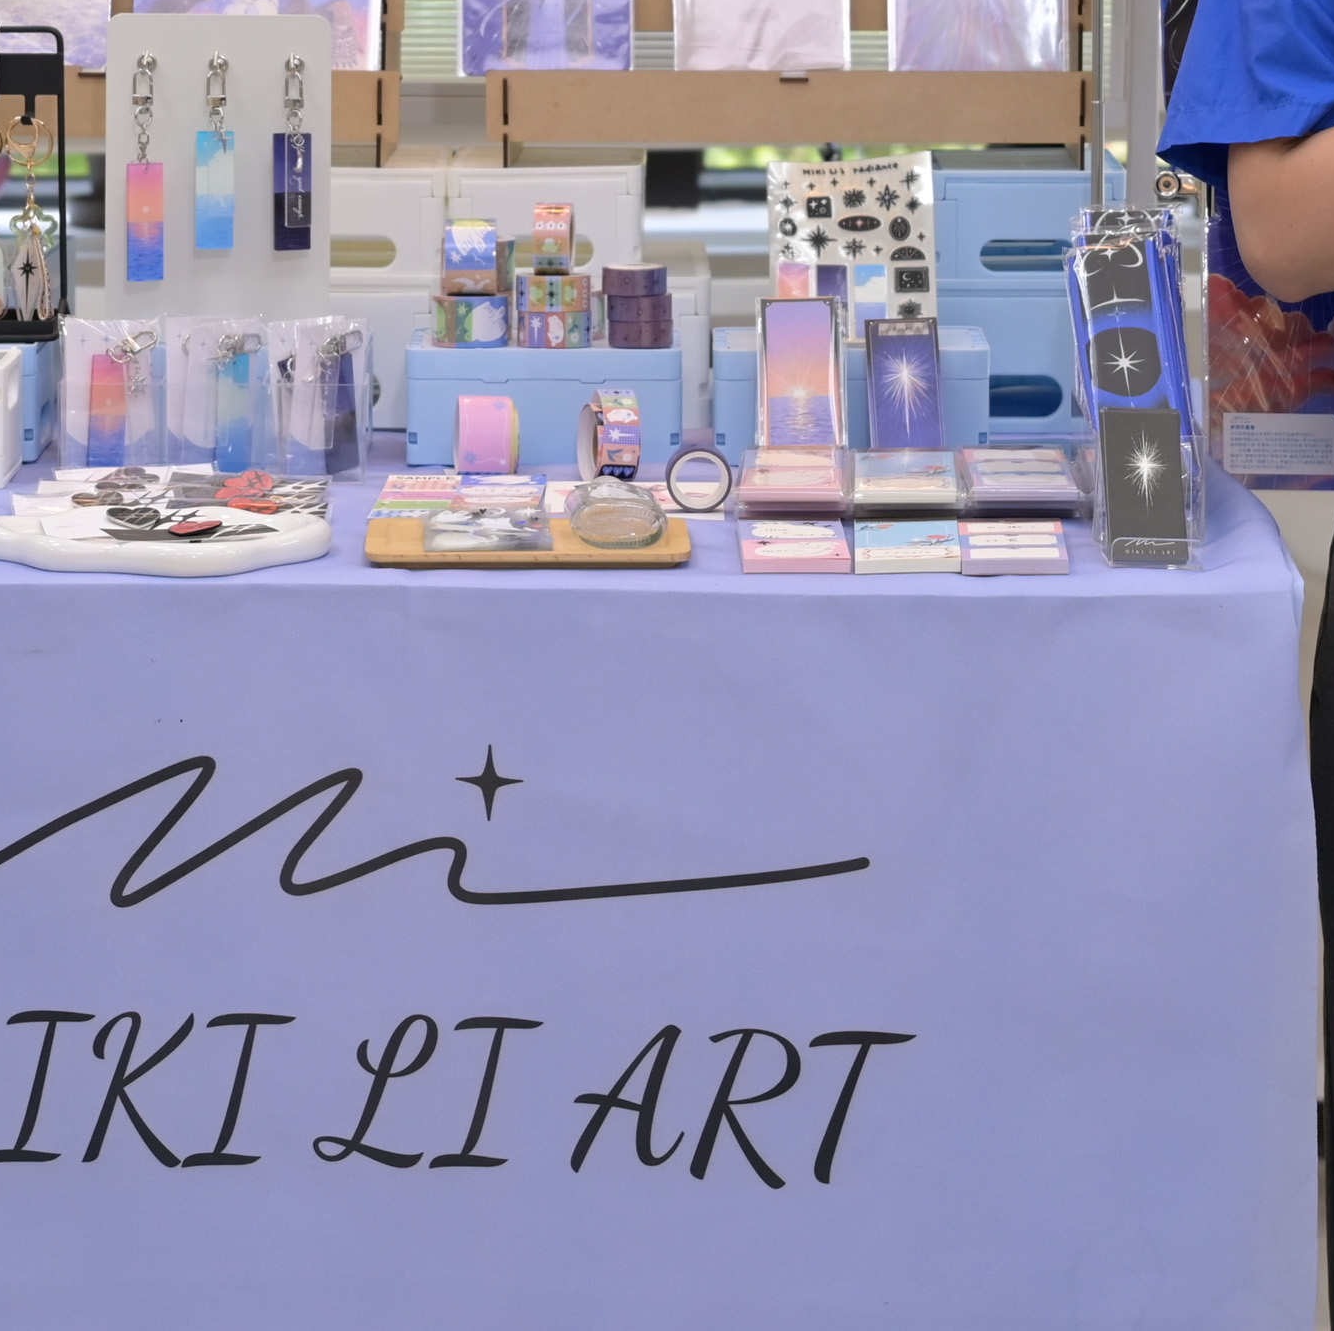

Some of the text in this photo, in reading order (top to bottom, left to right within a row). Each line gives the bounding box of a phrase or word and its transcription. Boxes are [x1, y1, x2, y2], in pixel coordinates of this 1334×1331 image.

[852, 162, 899, 175] radiance
[312, 1013, 545, 1170] LI
[570, 1024, 918, 1190] ART
